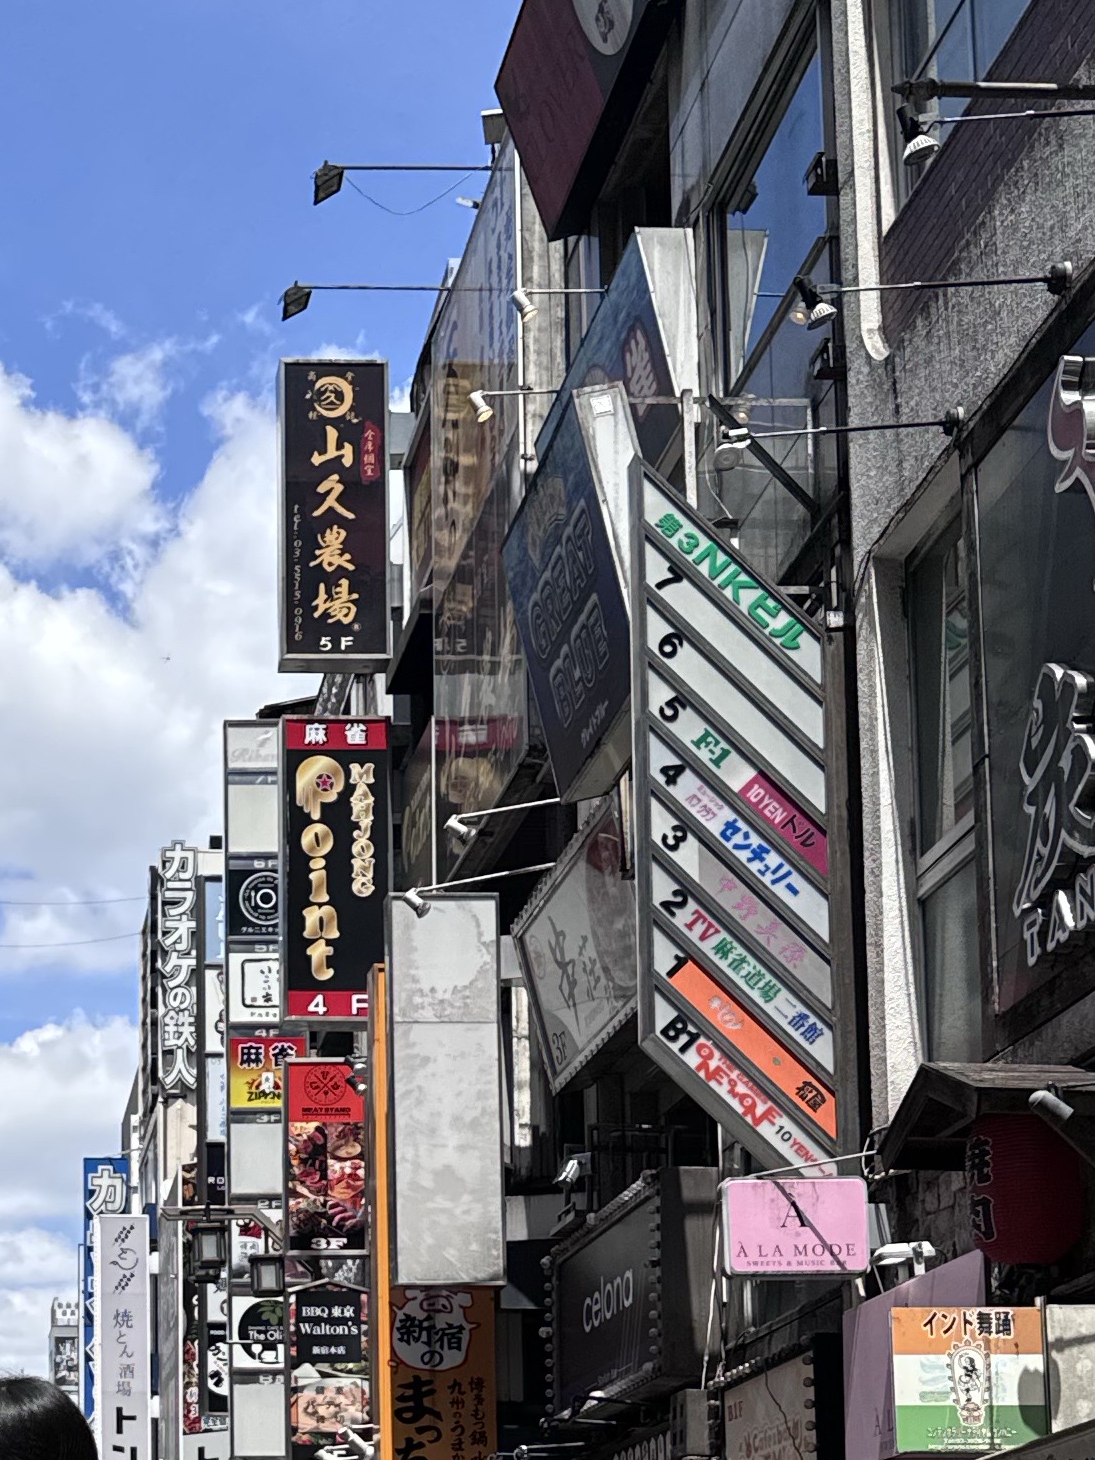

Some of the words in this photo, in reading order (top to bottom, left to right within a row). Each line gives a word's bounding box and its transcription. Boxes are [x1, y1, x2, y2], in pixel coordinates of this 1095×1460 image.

[309, 424, 359, 626] 山久農場
[528, 498, 595, 660] GREAT
[655, 565, 684, 590] 7
[655, 513, 803, 650] 第3NKビル
[658, 632, 684, 659] 6
[549, 592, 610, 729] BLUE
[659, 695, 687, 723] 5
[304, 723, 369, 746] 麻雀
[660, 764, 687, 787] 4
[349, 762, 376, 898] MAHJONG
[662, 825, 688, 852] 3
[296, 755, 345, 981] Point
[719, 818, 800, 897] センチュリー
[660, 889, 689, 918] 2
[162, 842, 197, 1090] カラオケの鉄人
[666, 953, 689, 979] 1
[684, 909, 721, 942] TV
[711, 937, 782, 1003] 麻雀道場
[660, 1014, 702, 1055] B1
[238, 1043, 297, 1069] 麻雀
[310, 1237, 348, 1250] 3F
[758, 1244, 785, 1258] LA
[793, 1243, 857, 1257] MODE
[301, 1306, 329, 1318] BBQ
[582, 1268, 635, 1333] celona
[299, 1321, 359, 1336] Walton's
[395, 1312, 466, 1351] 新宿
[923, 1310, 1013, 1337] インド舞踊
[420, 1349, 444, 1369] の
